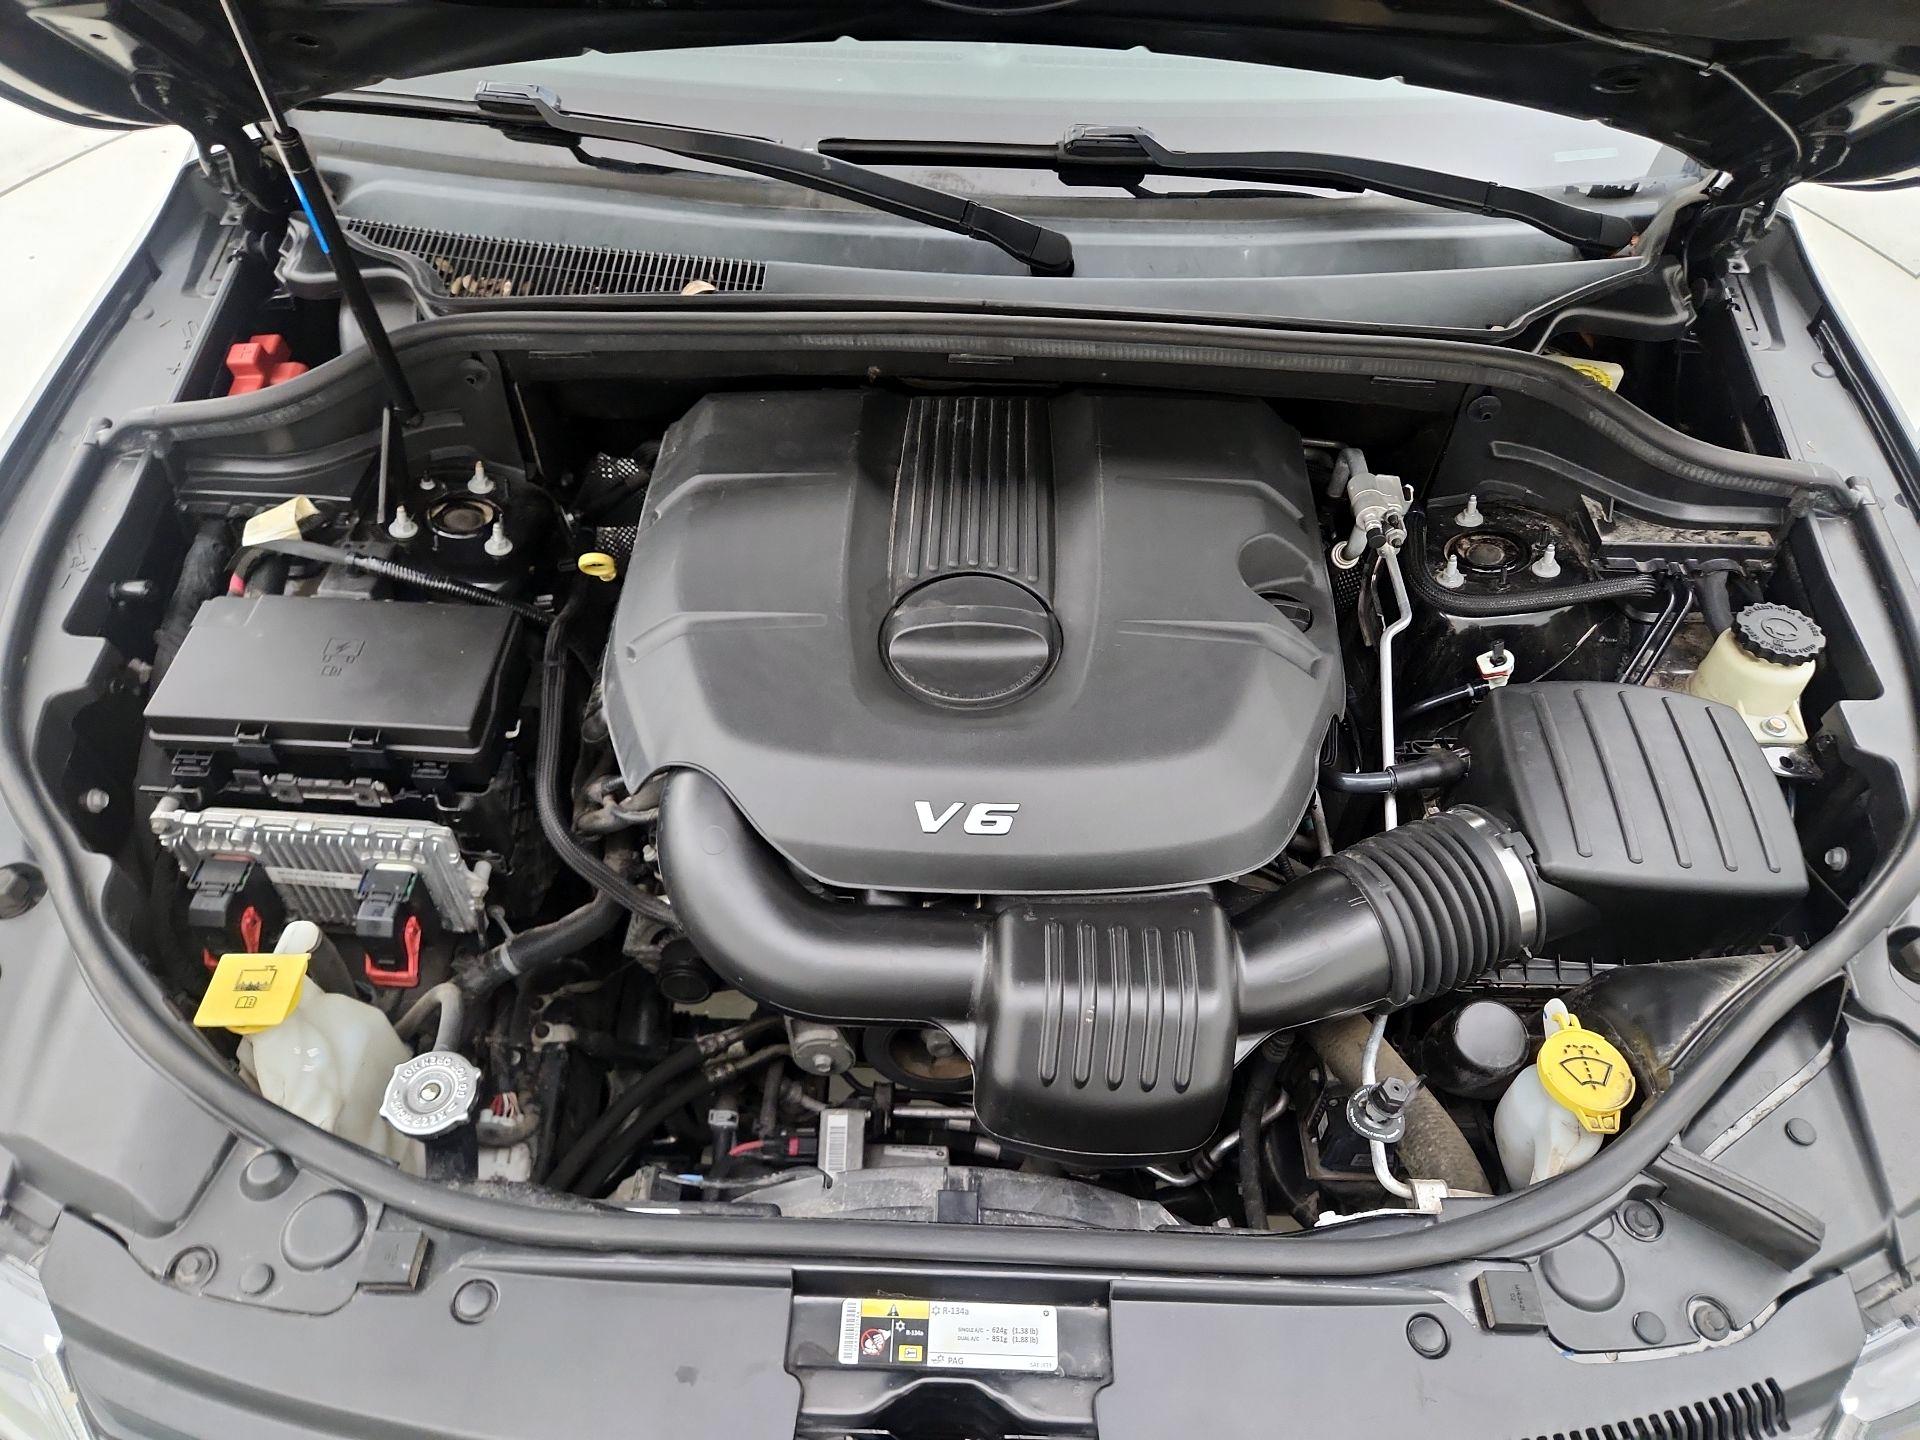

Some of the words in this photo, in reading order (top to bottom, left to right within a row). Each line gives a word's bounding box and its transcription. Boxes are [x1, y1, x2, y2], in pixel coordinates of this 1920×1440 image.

[914, 800, 1021, 836] V6
[421, 1056, 452, 1067] OPEN
[942, 1306, 970, 1316] R-134a
[991, 1326, 1008, 1335] 624g
[1012, 1327, 1029, 1336] (1.38
[1029, 1327, 1039, 1336] lb)
[991, 1335, 1008, 1344] 851g
[1029, 1336, 1039, 1344] lb)
[947, 1356, 964, 1365] PAG
